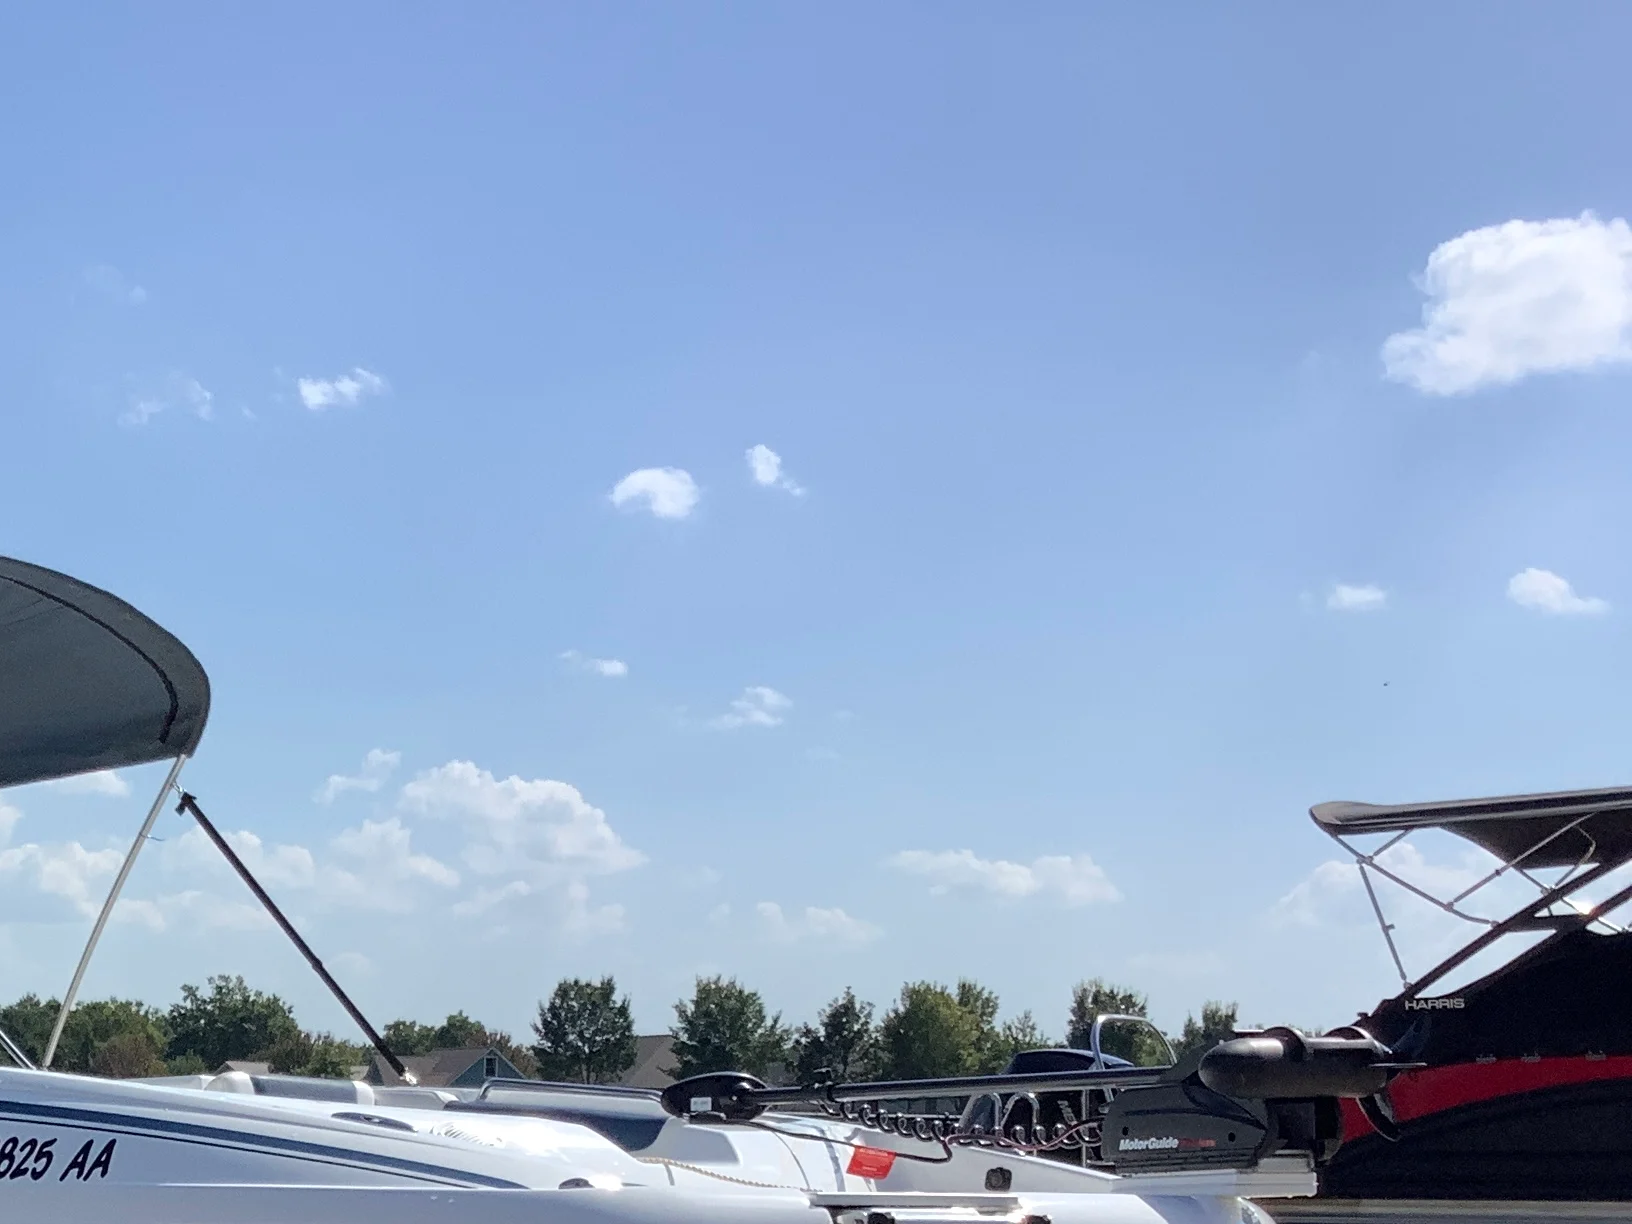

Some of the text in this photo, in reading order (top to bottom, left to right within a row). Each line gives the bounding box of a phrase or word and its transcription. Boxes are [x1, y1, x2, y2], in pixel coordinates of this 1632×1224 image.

[1404, 998, 1466, 1011] HARRIS
[1118, 1136, 1180, 1151] MotorGuide
[58, 1138, 117, 1182] AA
